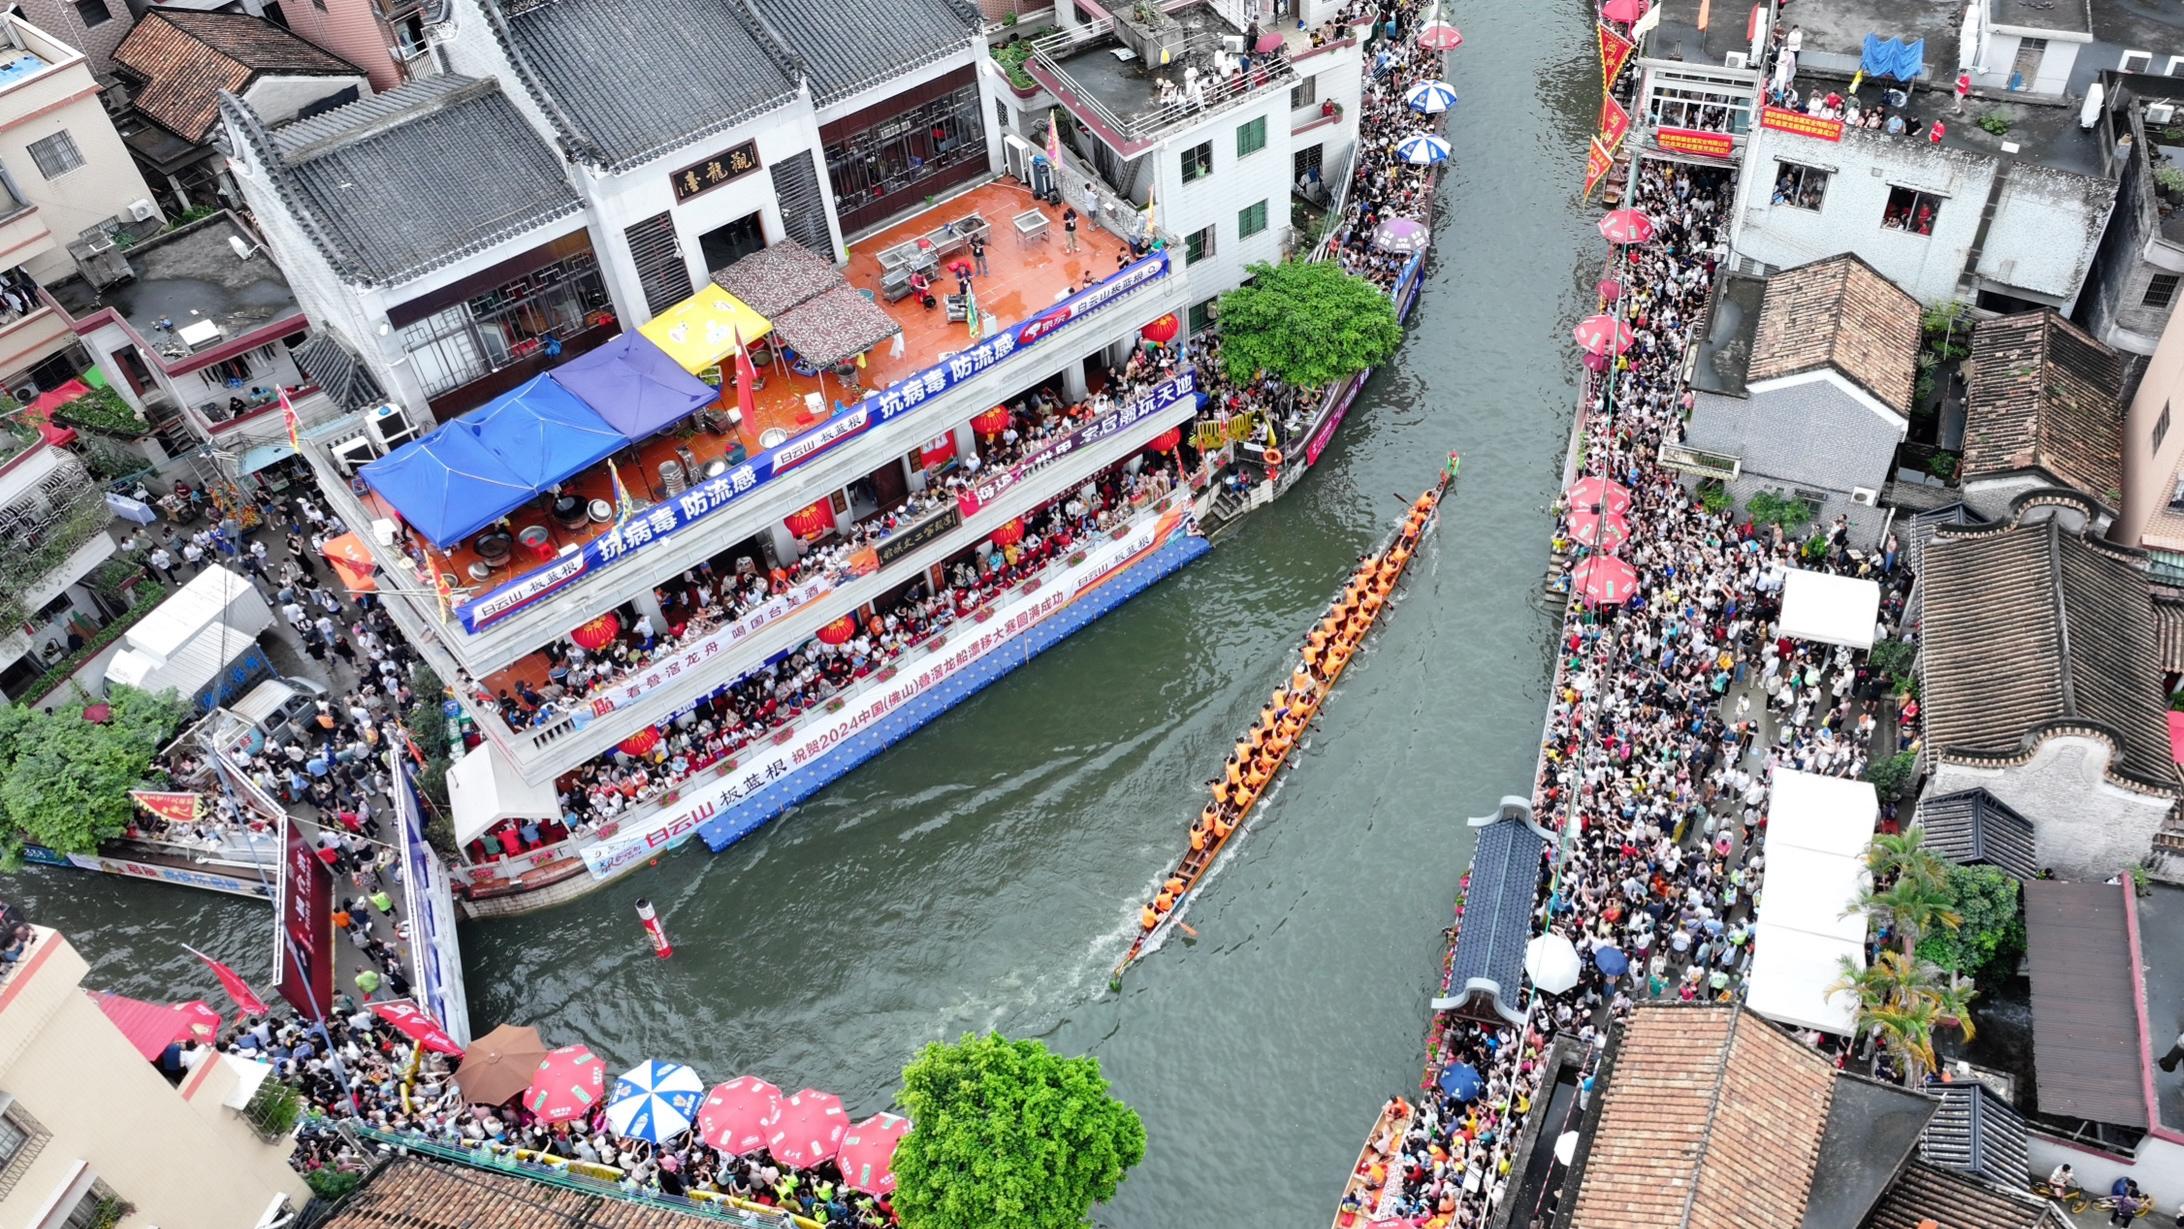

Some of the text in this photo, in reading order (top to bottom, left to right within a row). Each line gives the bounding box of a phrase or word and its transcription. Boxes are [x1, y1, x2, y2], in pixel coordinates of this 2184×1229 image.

[1041, 271, 1143, 332] 京东 白云山板蓝根
[880, 332, 1016, 419] 抗病毒 防流感
[781, 415, 861, 464] 白云山 板蓝根
[598, 465, 757, 561] 抗病毒 防流感
[481, 562, 578, 616] 白云山 板蓝根
[1078, 535, 1150, 587] 白云山 板蓝根
[644, 801, 716, 848] 白云山
[720, 758, 788, 807] 板蓝根
